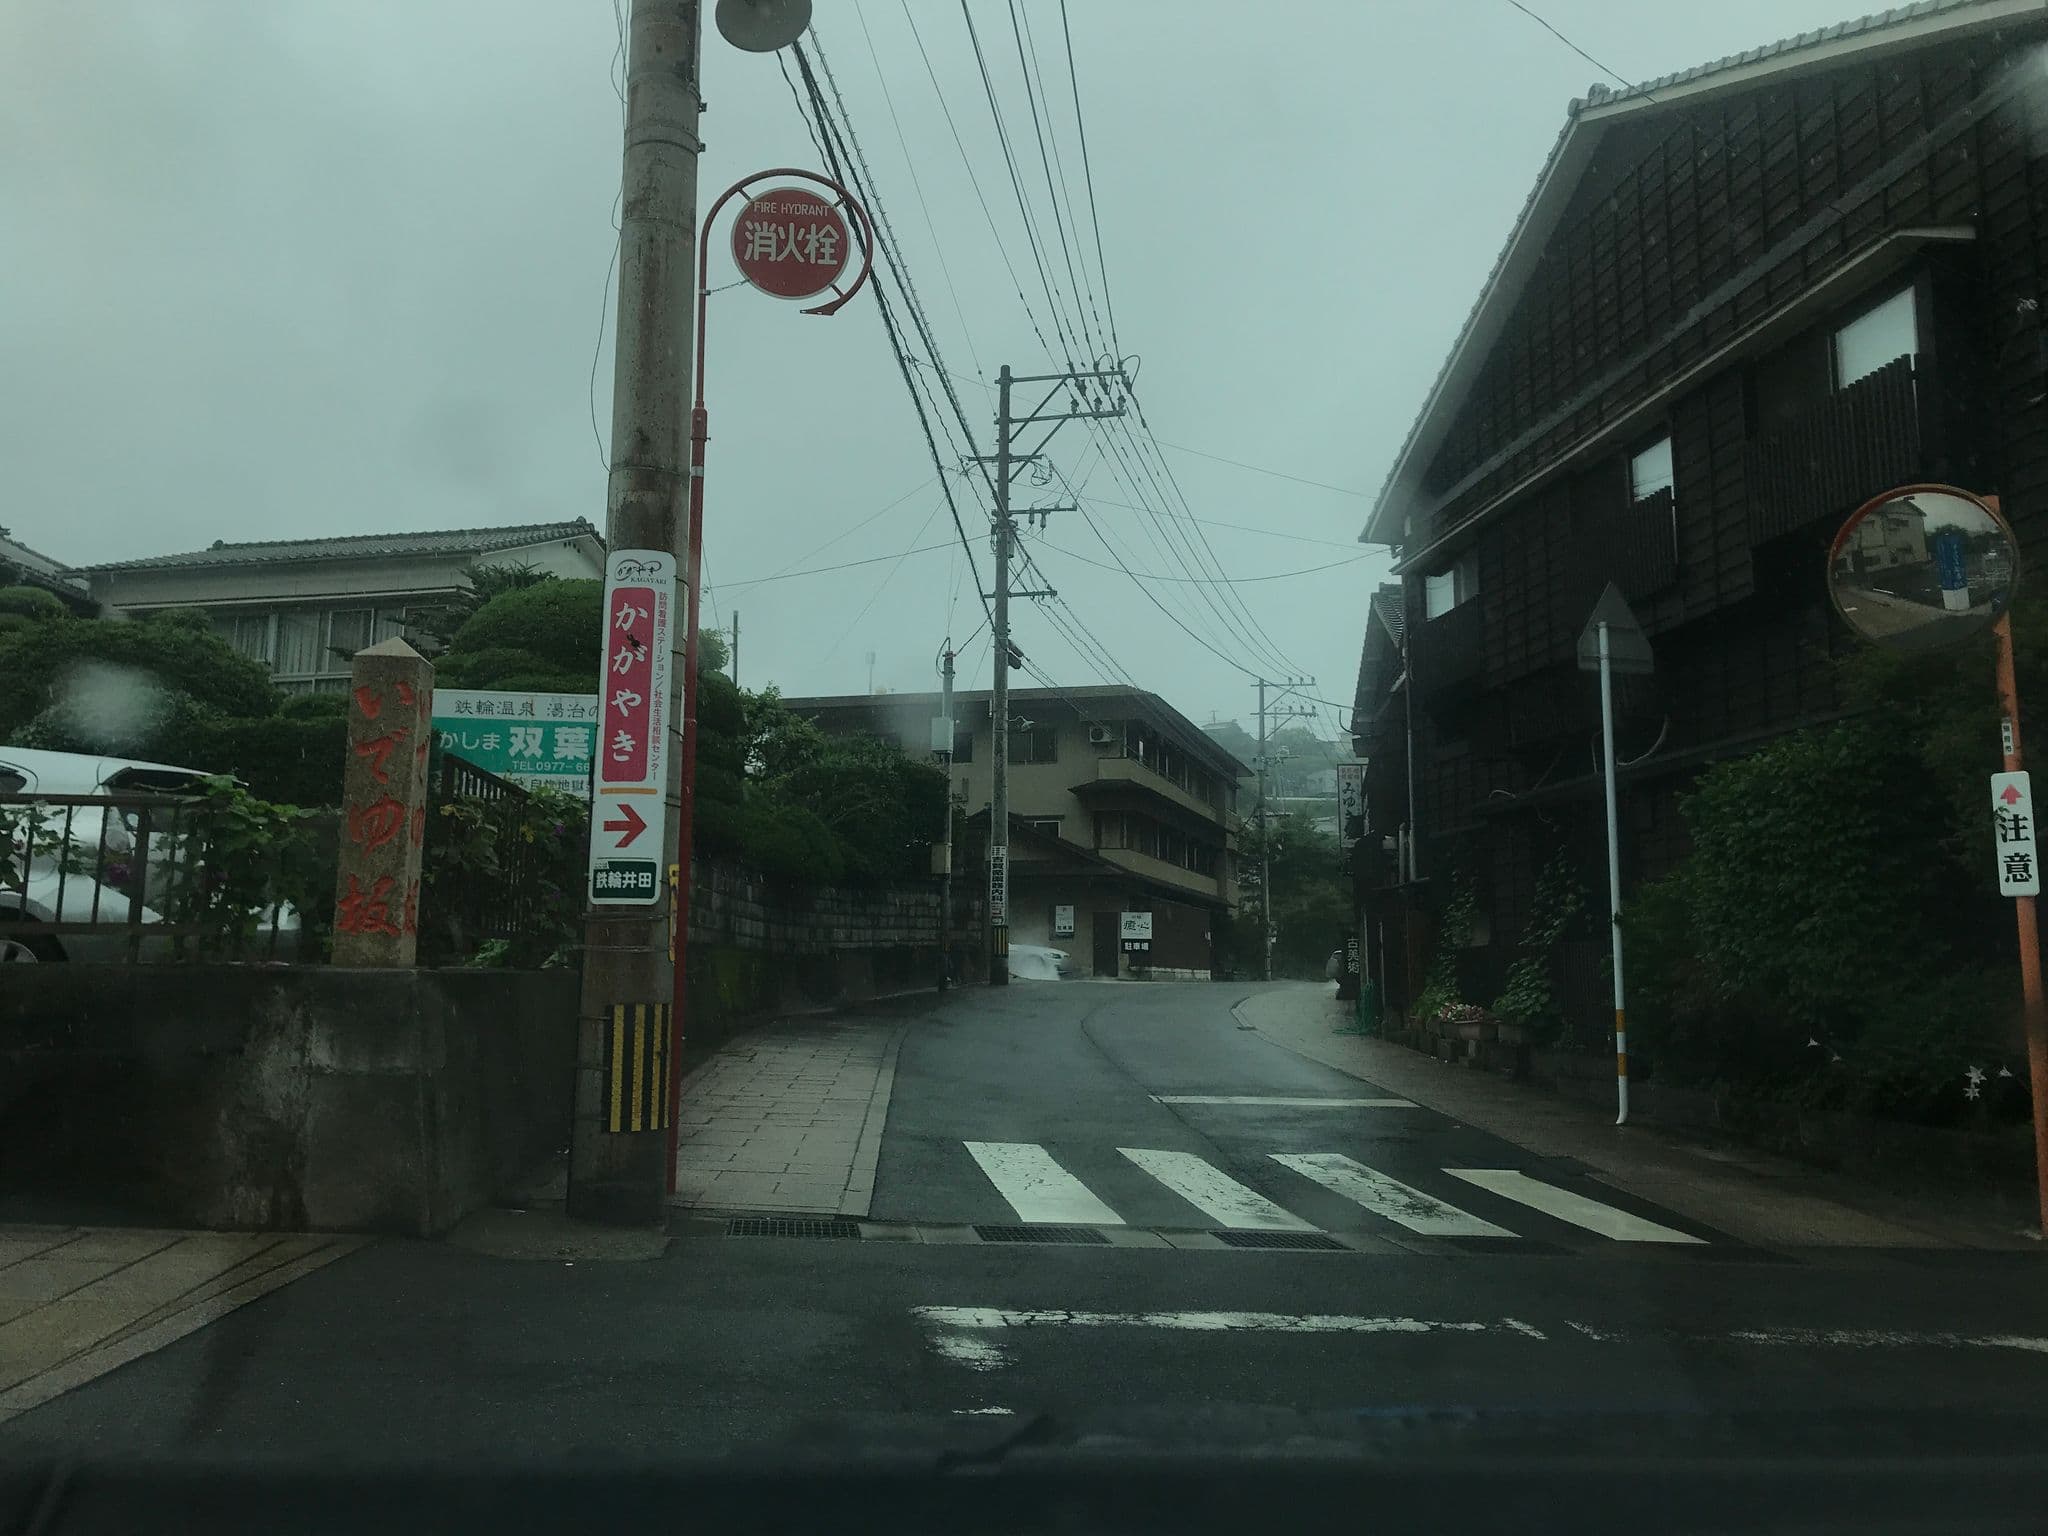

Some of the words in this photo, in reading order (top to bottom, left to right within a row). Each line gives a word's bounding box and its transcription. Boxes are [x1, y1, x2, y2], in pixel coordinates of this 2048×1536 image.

[753, 201, 777, 214] FIRE
[780, 202, 830, 217] HYDRANT
[743, 220, 840, 266] 消火栓
[609, 602, 648, 763] かがやき
[454, 699, 536, 717] 鉄輪温泉
[440, 731, 502, 751] かしま
[508, 726, 590, 761] 双葉
[1998, 813, 2033, 884] 注意
[595, 871, 652, 889] 鉄輪井田
